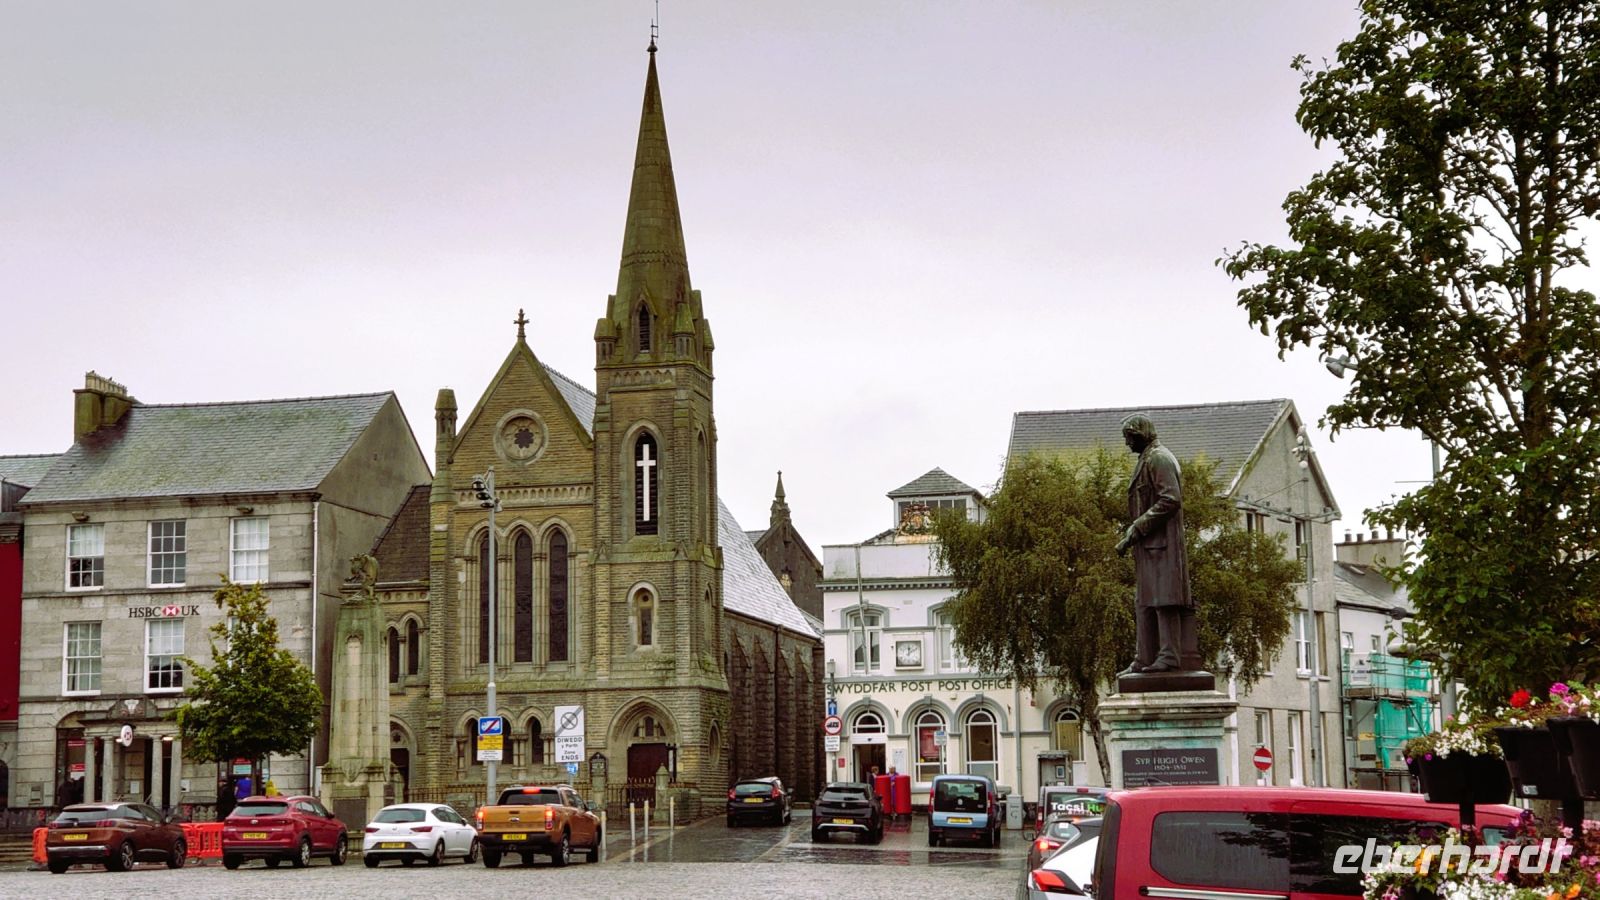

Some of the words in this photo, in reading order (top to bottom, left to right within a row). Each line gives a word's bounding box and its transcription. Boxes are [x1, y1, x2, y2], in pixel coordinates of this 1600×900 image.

[128, 606, 161, 618] HSBC
[181, 605, 200, 616] UK
[826, 682, 896, 695] SWYDDFA'R
[901, 681, 932, 692] POST
[938, 680, 969, 691] POST
[972, 679, 1012, 690] OFFICE
[1153, 756, 1177, 764] HUGH
[1180, 755, 1205, 763] OWEN
[1050, 802, 1084, 812] Tacsi
[1087, 802, 1104, 813] Hu
